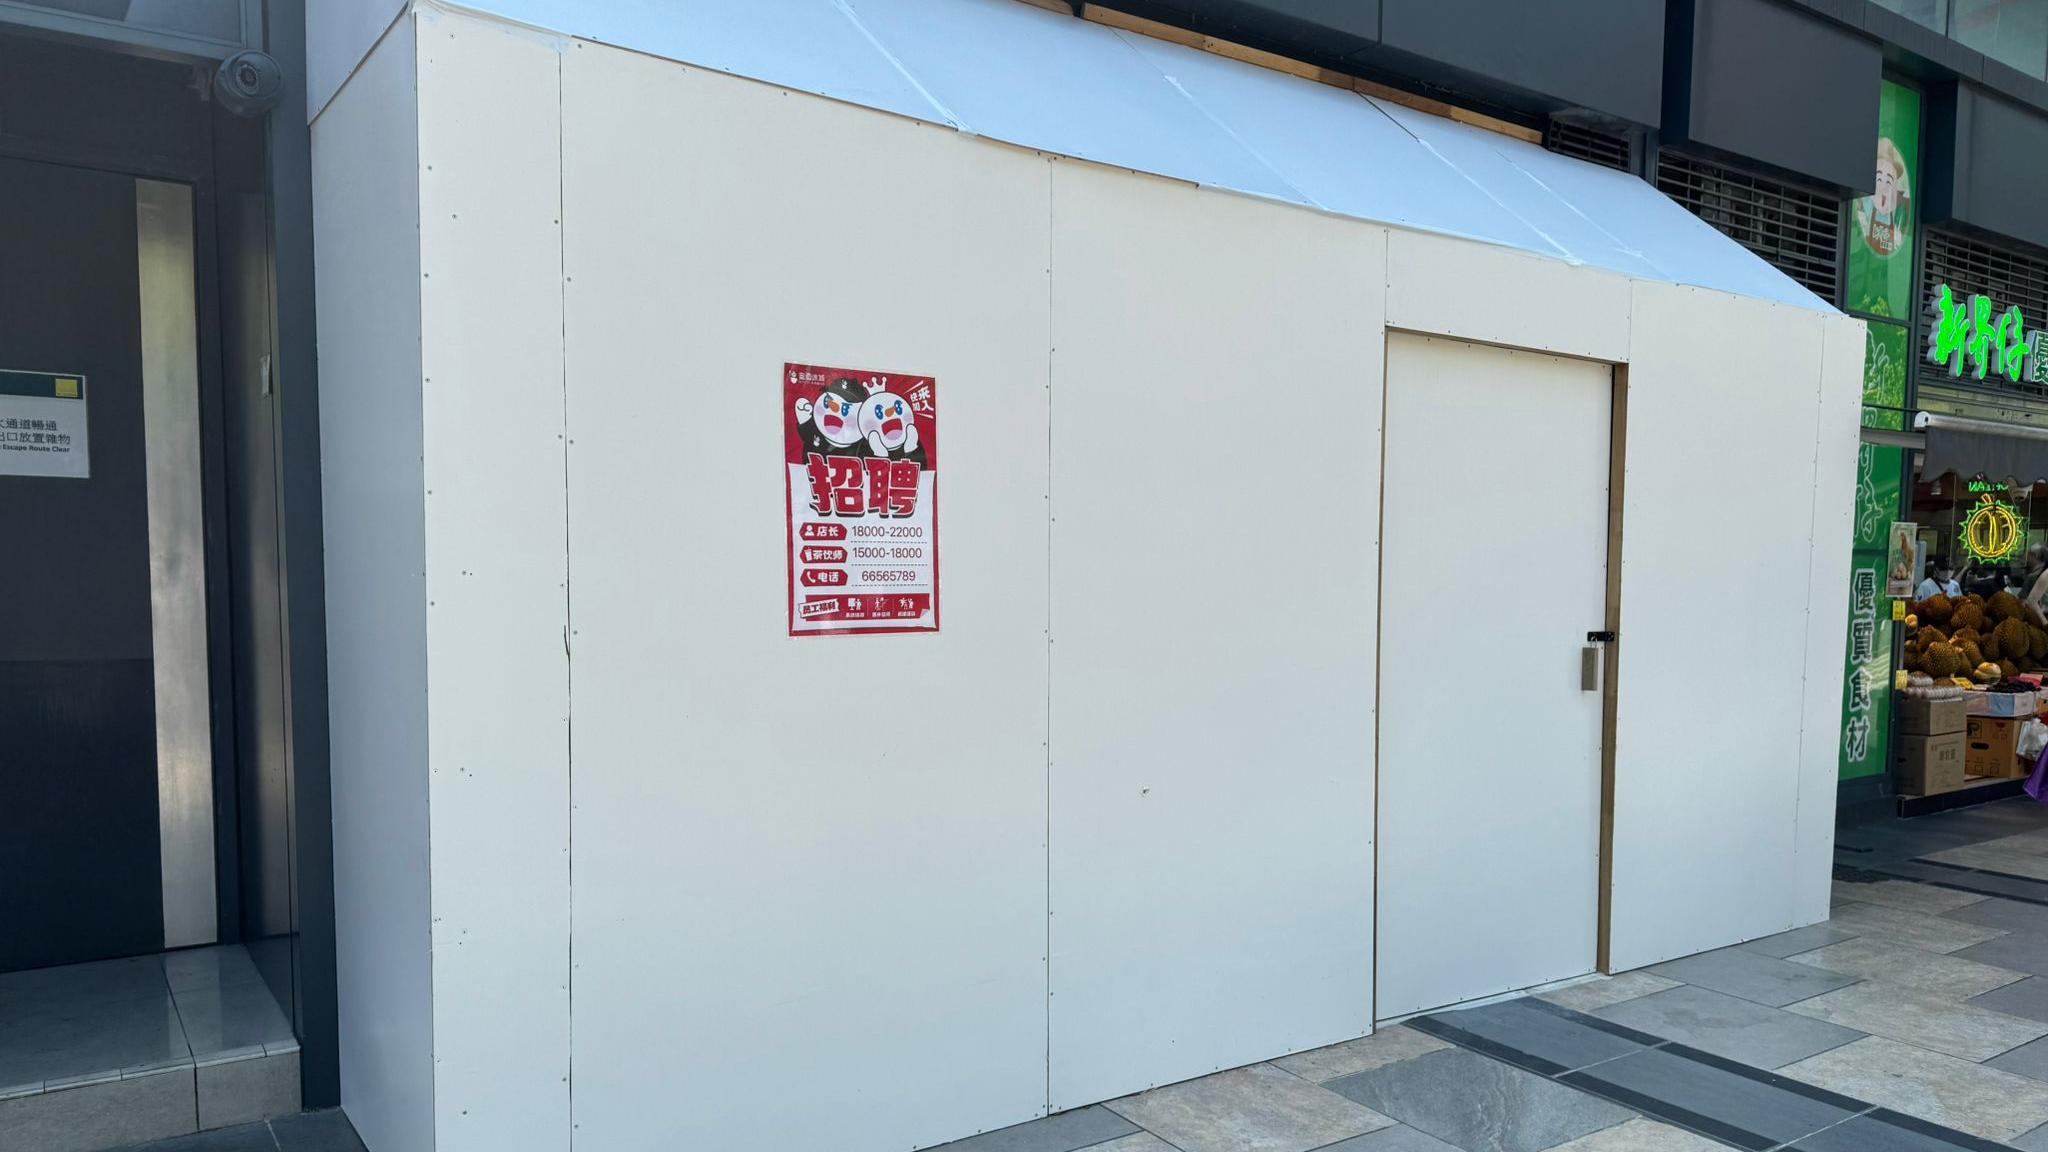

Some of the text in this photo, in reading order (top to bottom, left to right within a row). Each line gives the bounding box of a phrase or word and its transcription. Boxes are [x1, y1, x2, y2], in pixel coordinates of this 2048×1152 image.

[3, 444, 27, 452] Escape
[807, 452, 920, 518] 招聘
[817, 526, 839, 537] 店长
[852, 525, 923, 538] 18000-22000
[812, 549, 843, 560] 茶饮师
[852, 547, 922, 559] 15000-18000
[817, 572, 839, 583] 电话
[861, 570, 916, 582] 66565789
[1846, 569, 1875, 761] 優質食材
